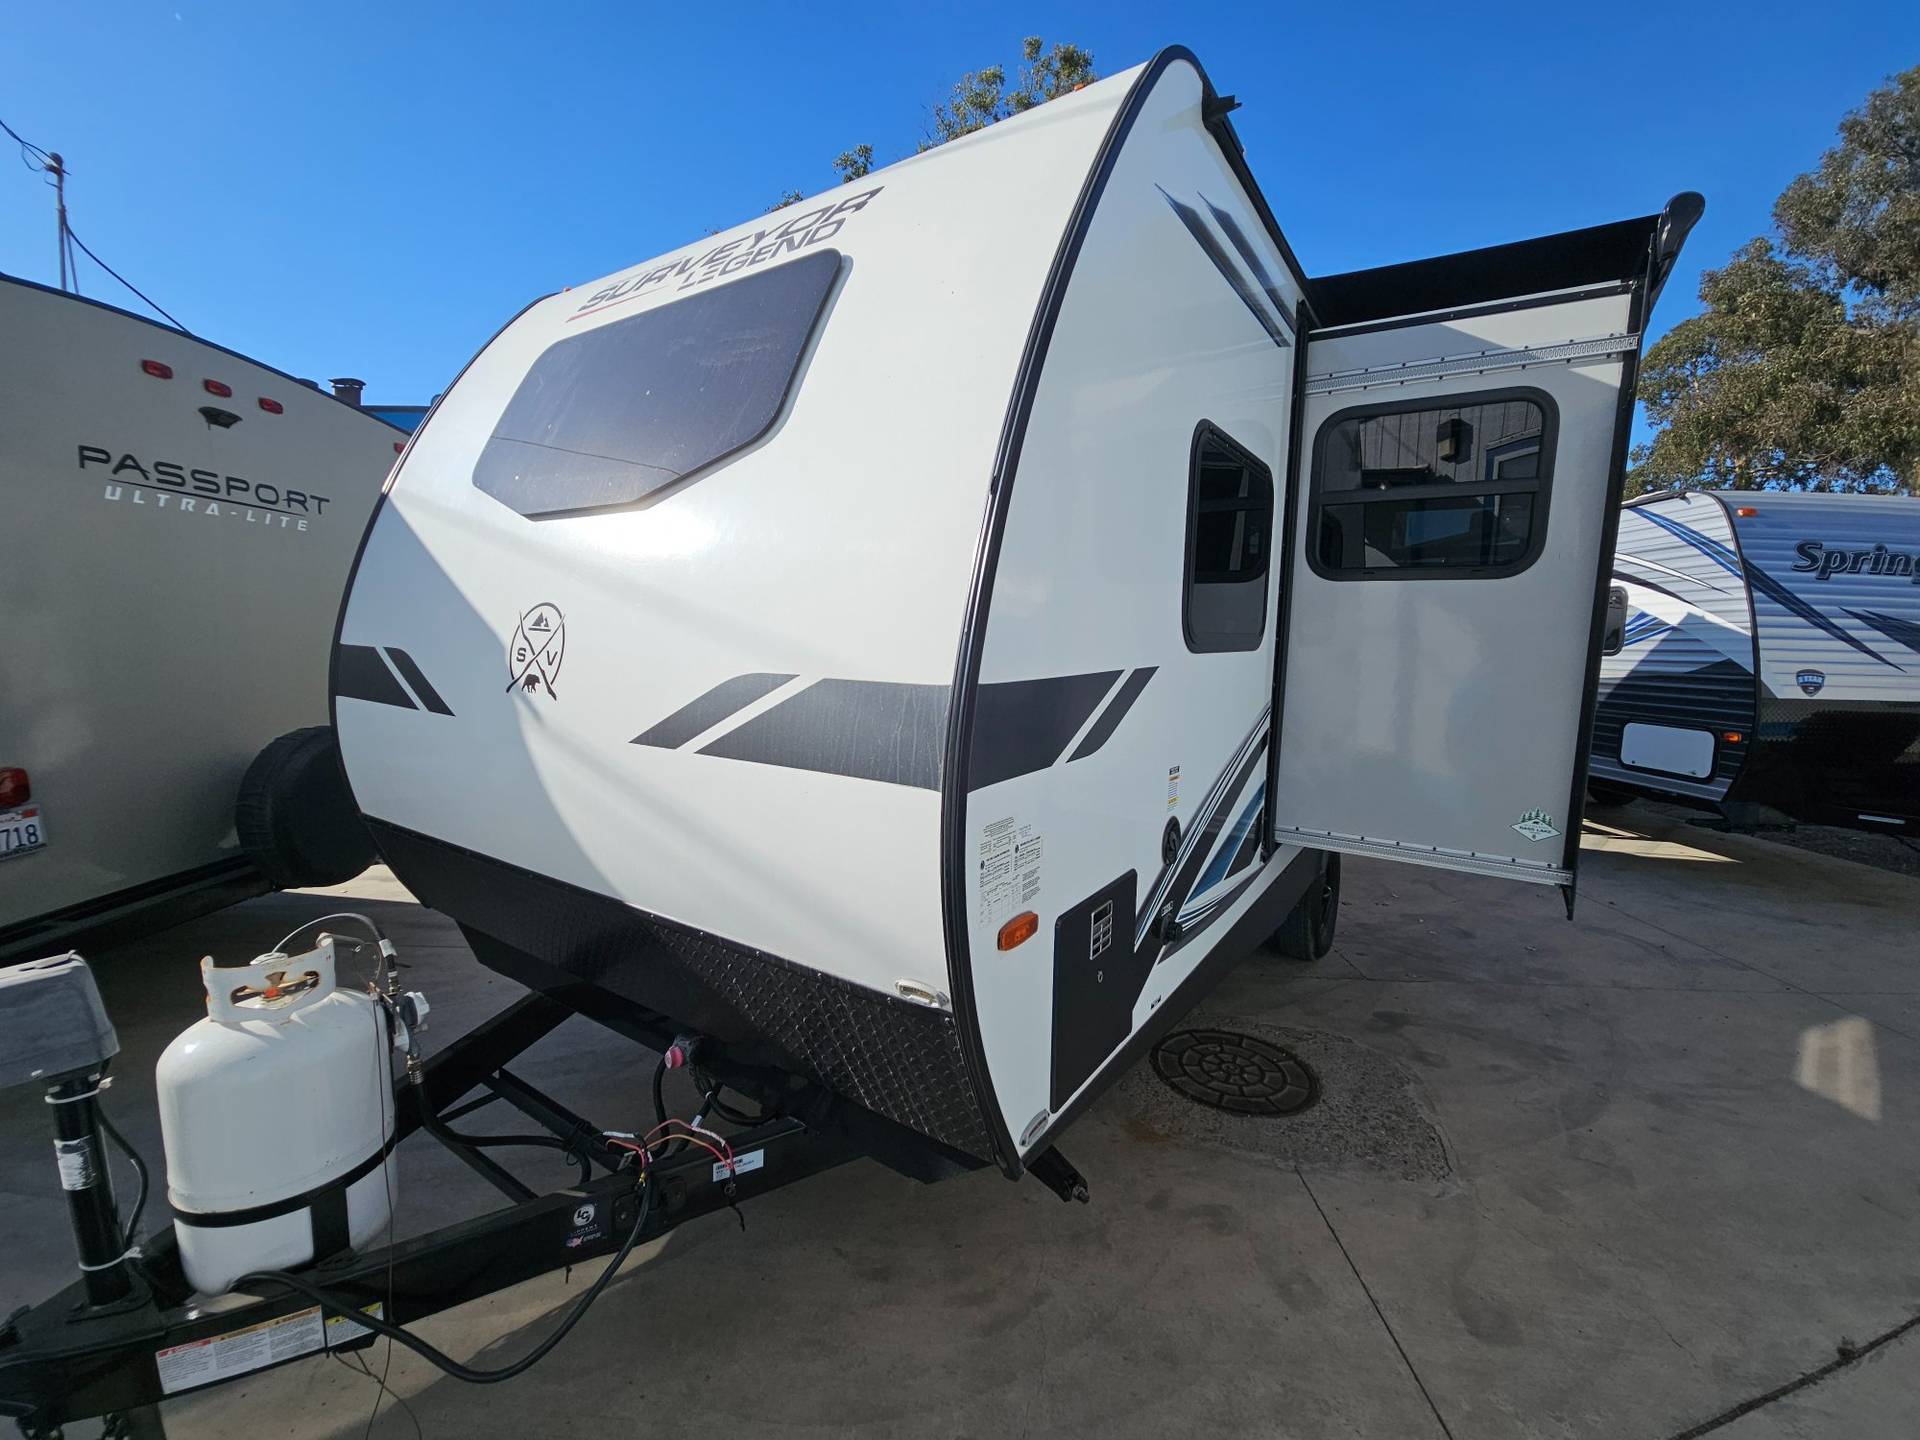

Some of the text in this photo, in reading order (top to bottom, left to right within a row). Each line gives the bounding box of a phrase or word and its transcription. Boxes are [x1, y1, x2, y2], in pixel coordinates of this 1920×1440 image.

[577, 186, 885, 312] SURVEYOR
[677, 217, 847, 292] LEGEND
[77, 444, 330, 515] PASSPORT
[103, 485, 309, 532] ULTRA-LITE
[516, 646, 558, 666] S V
[0, 823, 39, 851] 718
